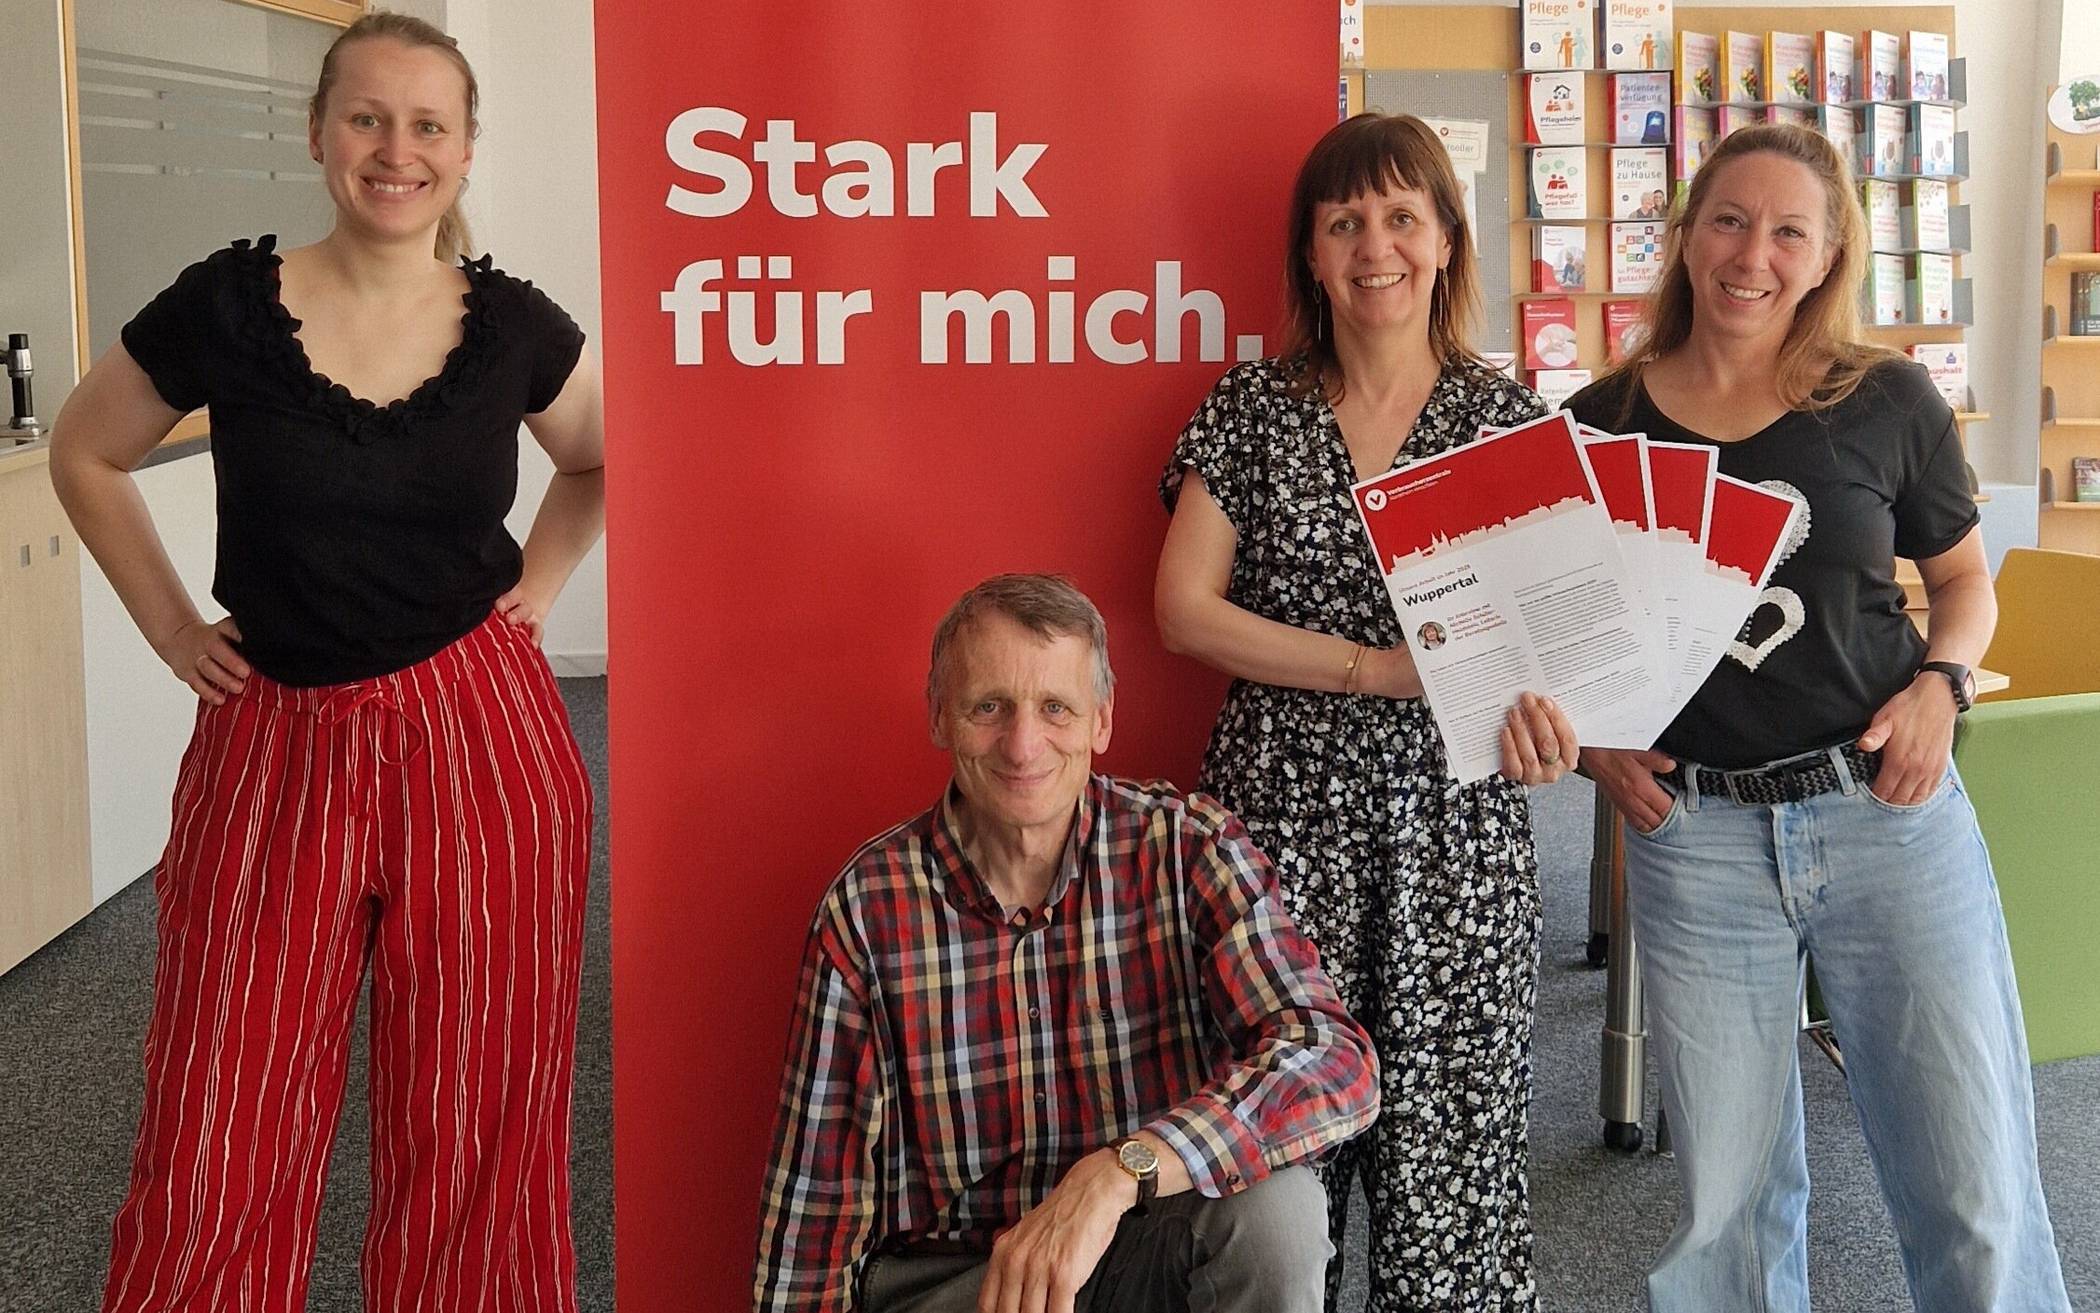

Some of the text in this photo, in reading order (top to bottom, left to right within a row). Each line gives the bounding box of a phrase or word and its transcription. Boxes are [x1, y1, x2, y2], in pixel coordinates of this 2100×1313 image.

[1529, 2, 1569, 17] Pflege
[1611, 4, 1649, 18] Pflege
[1540, 115, 1581, 124] Pflegeheim
[665, 107, 1049, 218] Stark
[1616, 159, 1648, 169] Pflege
[1616, 170, 1662, 179] zu Hause
[661, 255, 1265, 367] für mich.
[1402, 573, 1479, 607] Wuppertal
